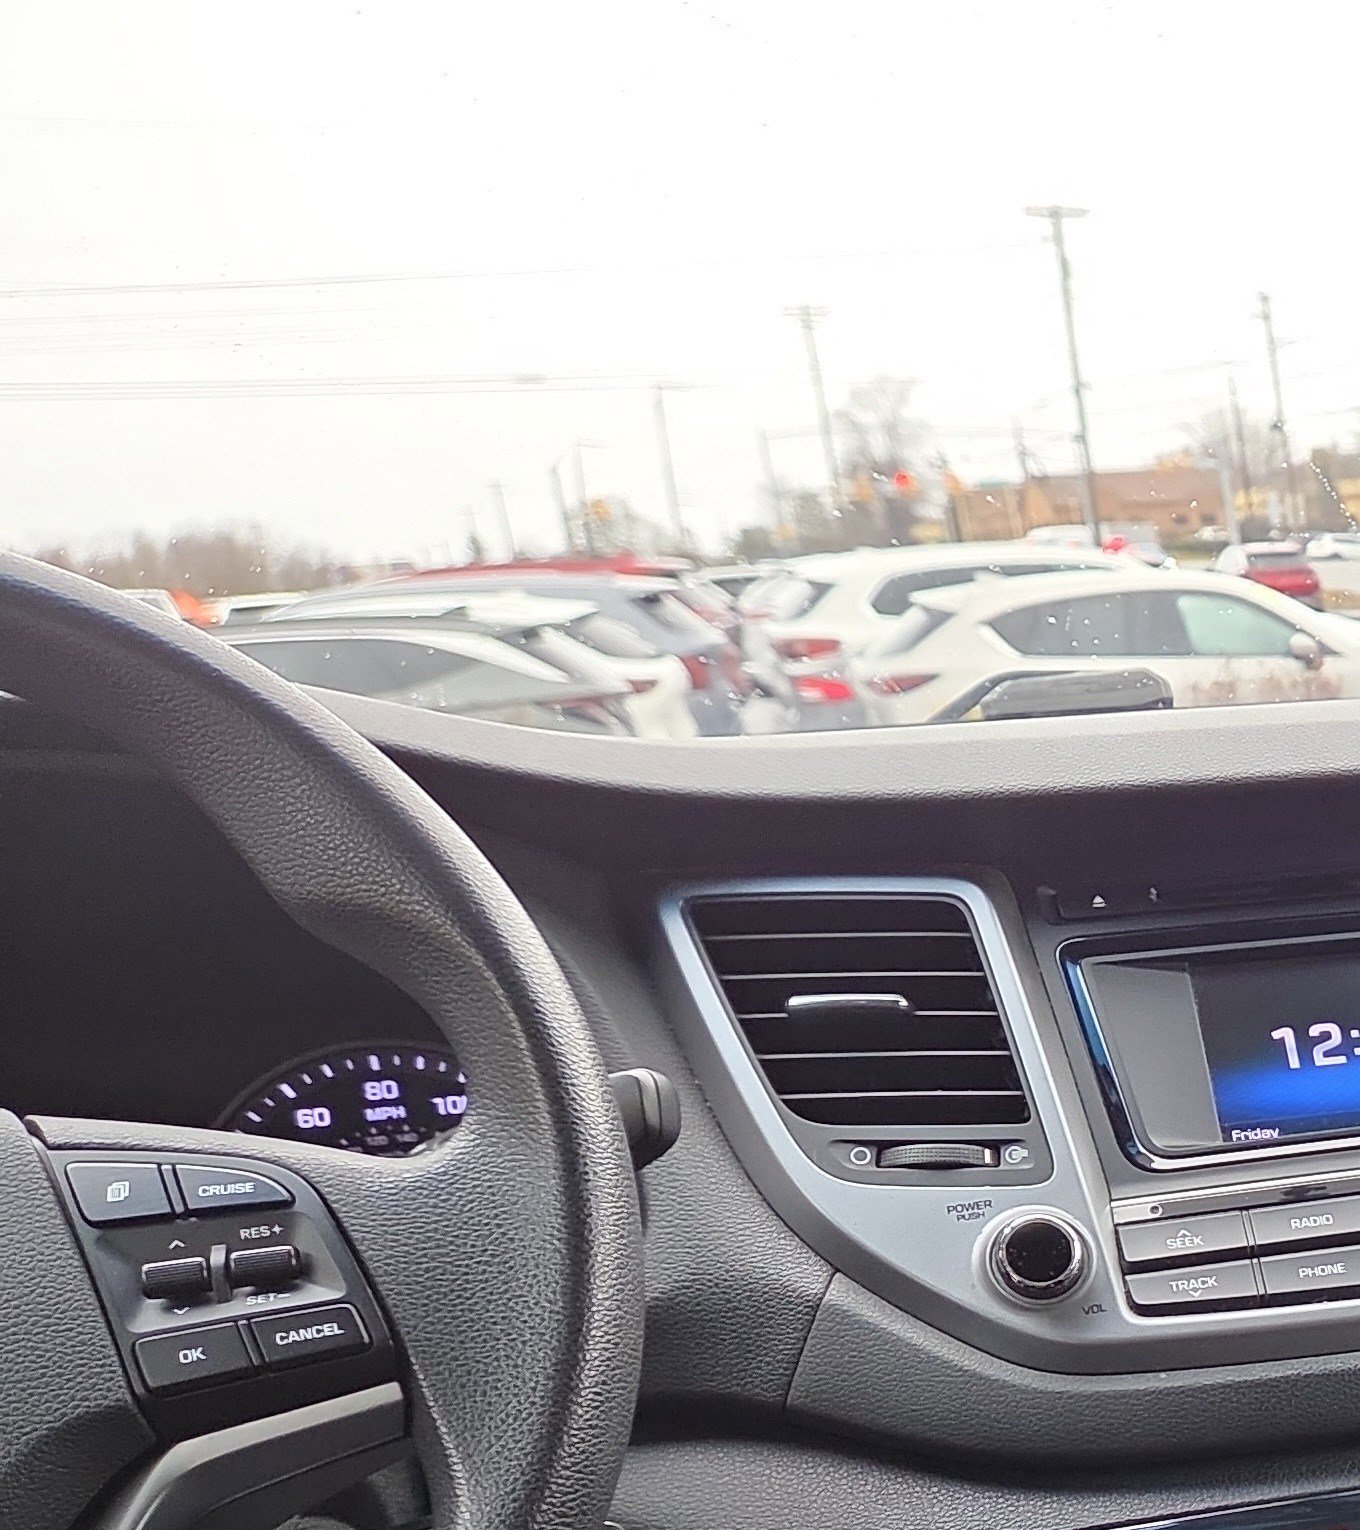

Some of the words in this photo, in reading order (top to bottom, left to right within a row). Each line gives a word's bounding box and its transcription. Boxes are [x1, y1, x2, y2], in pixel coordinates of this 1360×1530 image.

[363, 1079, 400, 1101] 80
[364, 1105, 407, 1122] MPH
[431, 1095, 468, 1116] 10
[296, 1107, 331, 1129] 60
[1231, 1127, 1280, 1142] Friday
[198, 1181, 256, 1198] CRUISE
[946, 1199, 993, 1216] POWER
[956, 1210, 986, 1222] PUSH
[1290, 1214, 1334, 1230] RADIO
[1166, 1234, 1205, 1250] SEEK
[1298, 1262, 1347, 1280] PHONE
[1169, 1275, 1218, 1293] TRACK
[1082, 1303, 1107, 1316] VOL
[275, 1322, 345, 1346] CANCEL
[178, 1346, 207, 1364] OK
